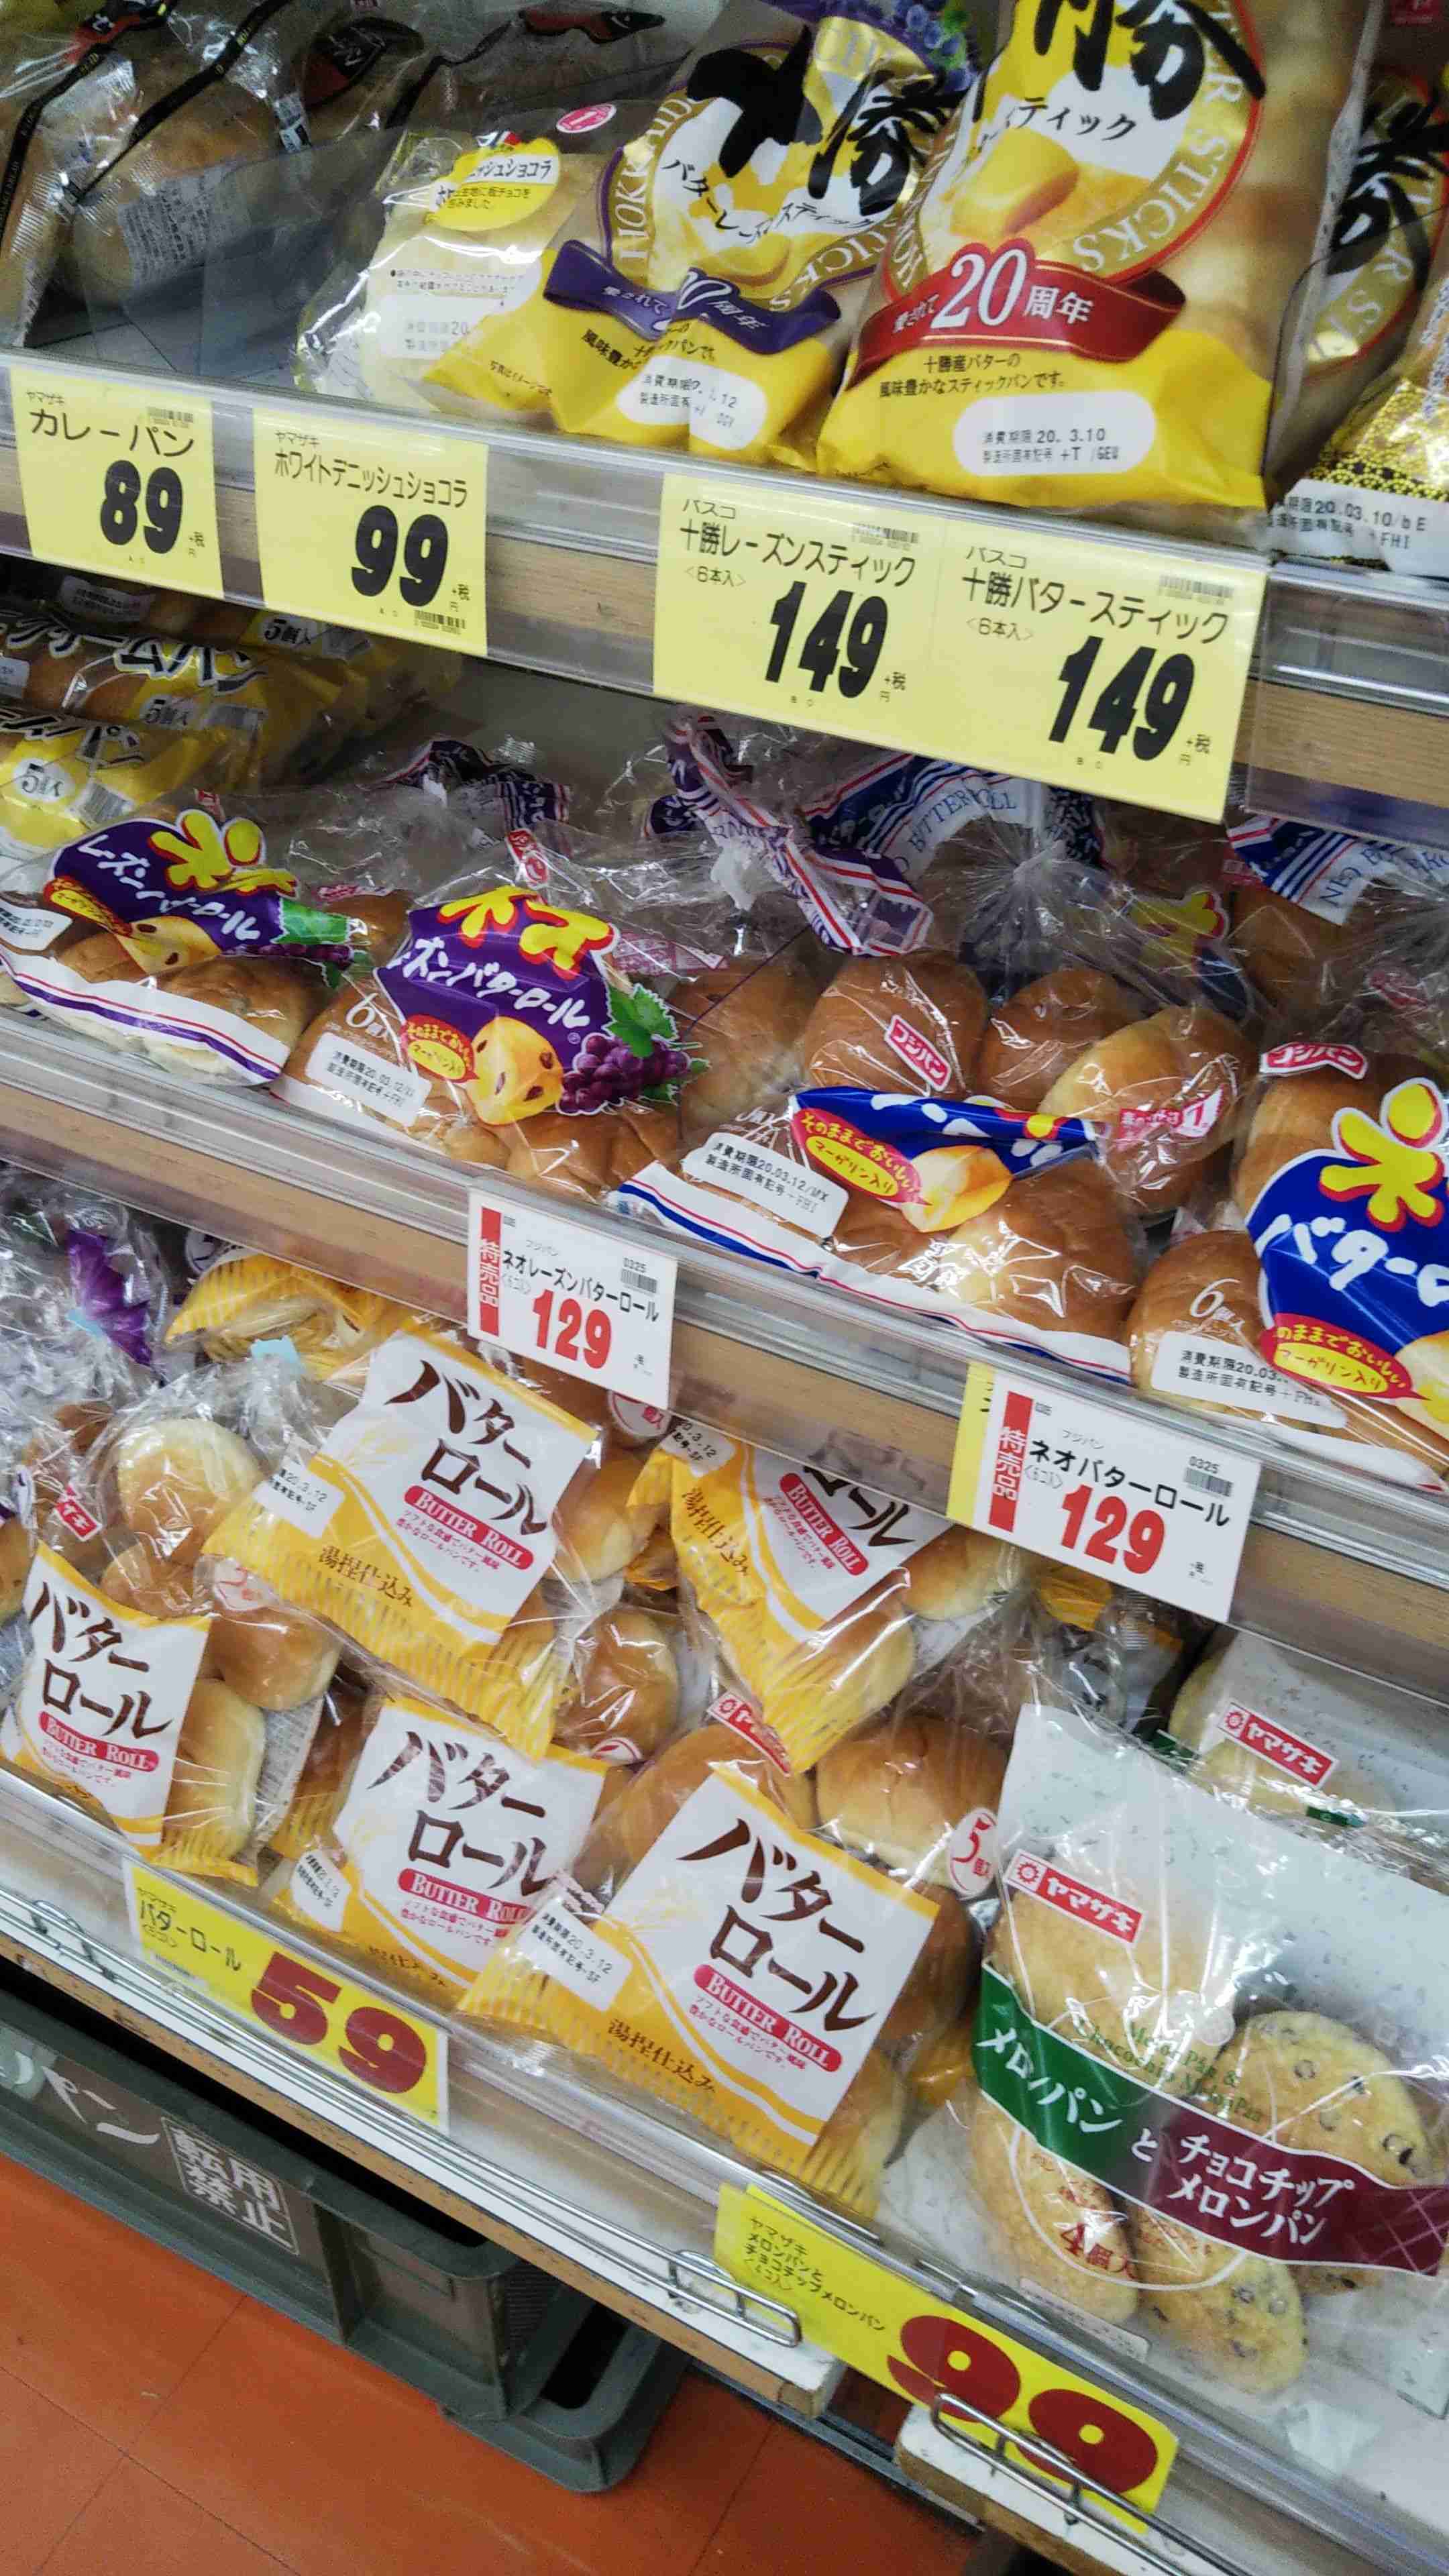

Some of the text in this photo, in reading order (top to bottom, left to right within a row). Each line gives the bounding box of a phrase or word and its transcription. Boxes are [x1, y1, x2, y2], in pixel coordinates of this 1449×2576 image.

[930, 247, 1028, 330] 20
[1023, 284, 1095, 325] 周年
[924, 352, 1021, 373] 十勝産バターの
[30, 408, 195, 458] カレーパン
[100, 460, 183, 554] 89
[274, 451, 468, 508] ホワイトデニッシュショコラ
[351, 504, 449, 607] 99
[680, 518, 916, 588] 十勝レーズンスティック
[764, 580, 889, 699] 149
[963, 566, 1229, 645] 十勝バタースティック
[1048, 634, 1195, 761] 149
[891, 1020, 947, 1080] フジパン
[1271, 1044, 1362, 1071] フジパン
[478, 1238, 501, 1308] 特売品
[502, 1249, 659, 1322] ネオレーズンバターロール
[533, 1288, 612, 1369] 129
[1276, 1324, 1406, 1389] のままでおいしい
[383, 1360, 532, 1470] バター
[420, 1438, 548, 1536] ロール
[992, 1426, 1026, 1501] 特売品
[1029, 1438, 1230, 1527] ネオバターロール
[1187, 1455, 1220, 1474] 0325
[415, 1490, 524, 1566] BUTTER ROLL
[788, 1484, 863, 1570] BUTTER ROLL
[1061, 1484, 1165, 1575] 129
[29, 1581, 150, 1673] バター
[42, 1658, 174, 1740] ロール
[106, 1744, 151, 1770] ROLL
[366, 1730, 546, 1819] バター
[1246, 1721, 1326, 1779] ヤマザキ
[407, 1809, 556, 1896] ロール
[676, 1818, 864, 1953] バター
[140, 1899, 242, 1972] バターロール
[410, 1874, 480, 1917] BUTTER
[1045, 1875, 1138, 1933] ヤマザキ
[709, 1904, 877, 2032] ロール
[251, 1951, 427, 2094] 59
[706, 1974, 831, 2065] BUTTER ROLL
[977, 2026, 1122, 2132] メロンパン
[1130, 2127, 1159, 2164] と
[1179, 2132, 1356, 2208] チョコチップ
[749, 2215, 809, 2256] ヤマザキ
[1166, 2175, 1327, 2246] メロンパン
[744, 2243, 886, 2332] チョコチップメロンパン
[747, 2231, 824, 2282] メロンパンと
[886, 2314, 1158, 2495] 99
